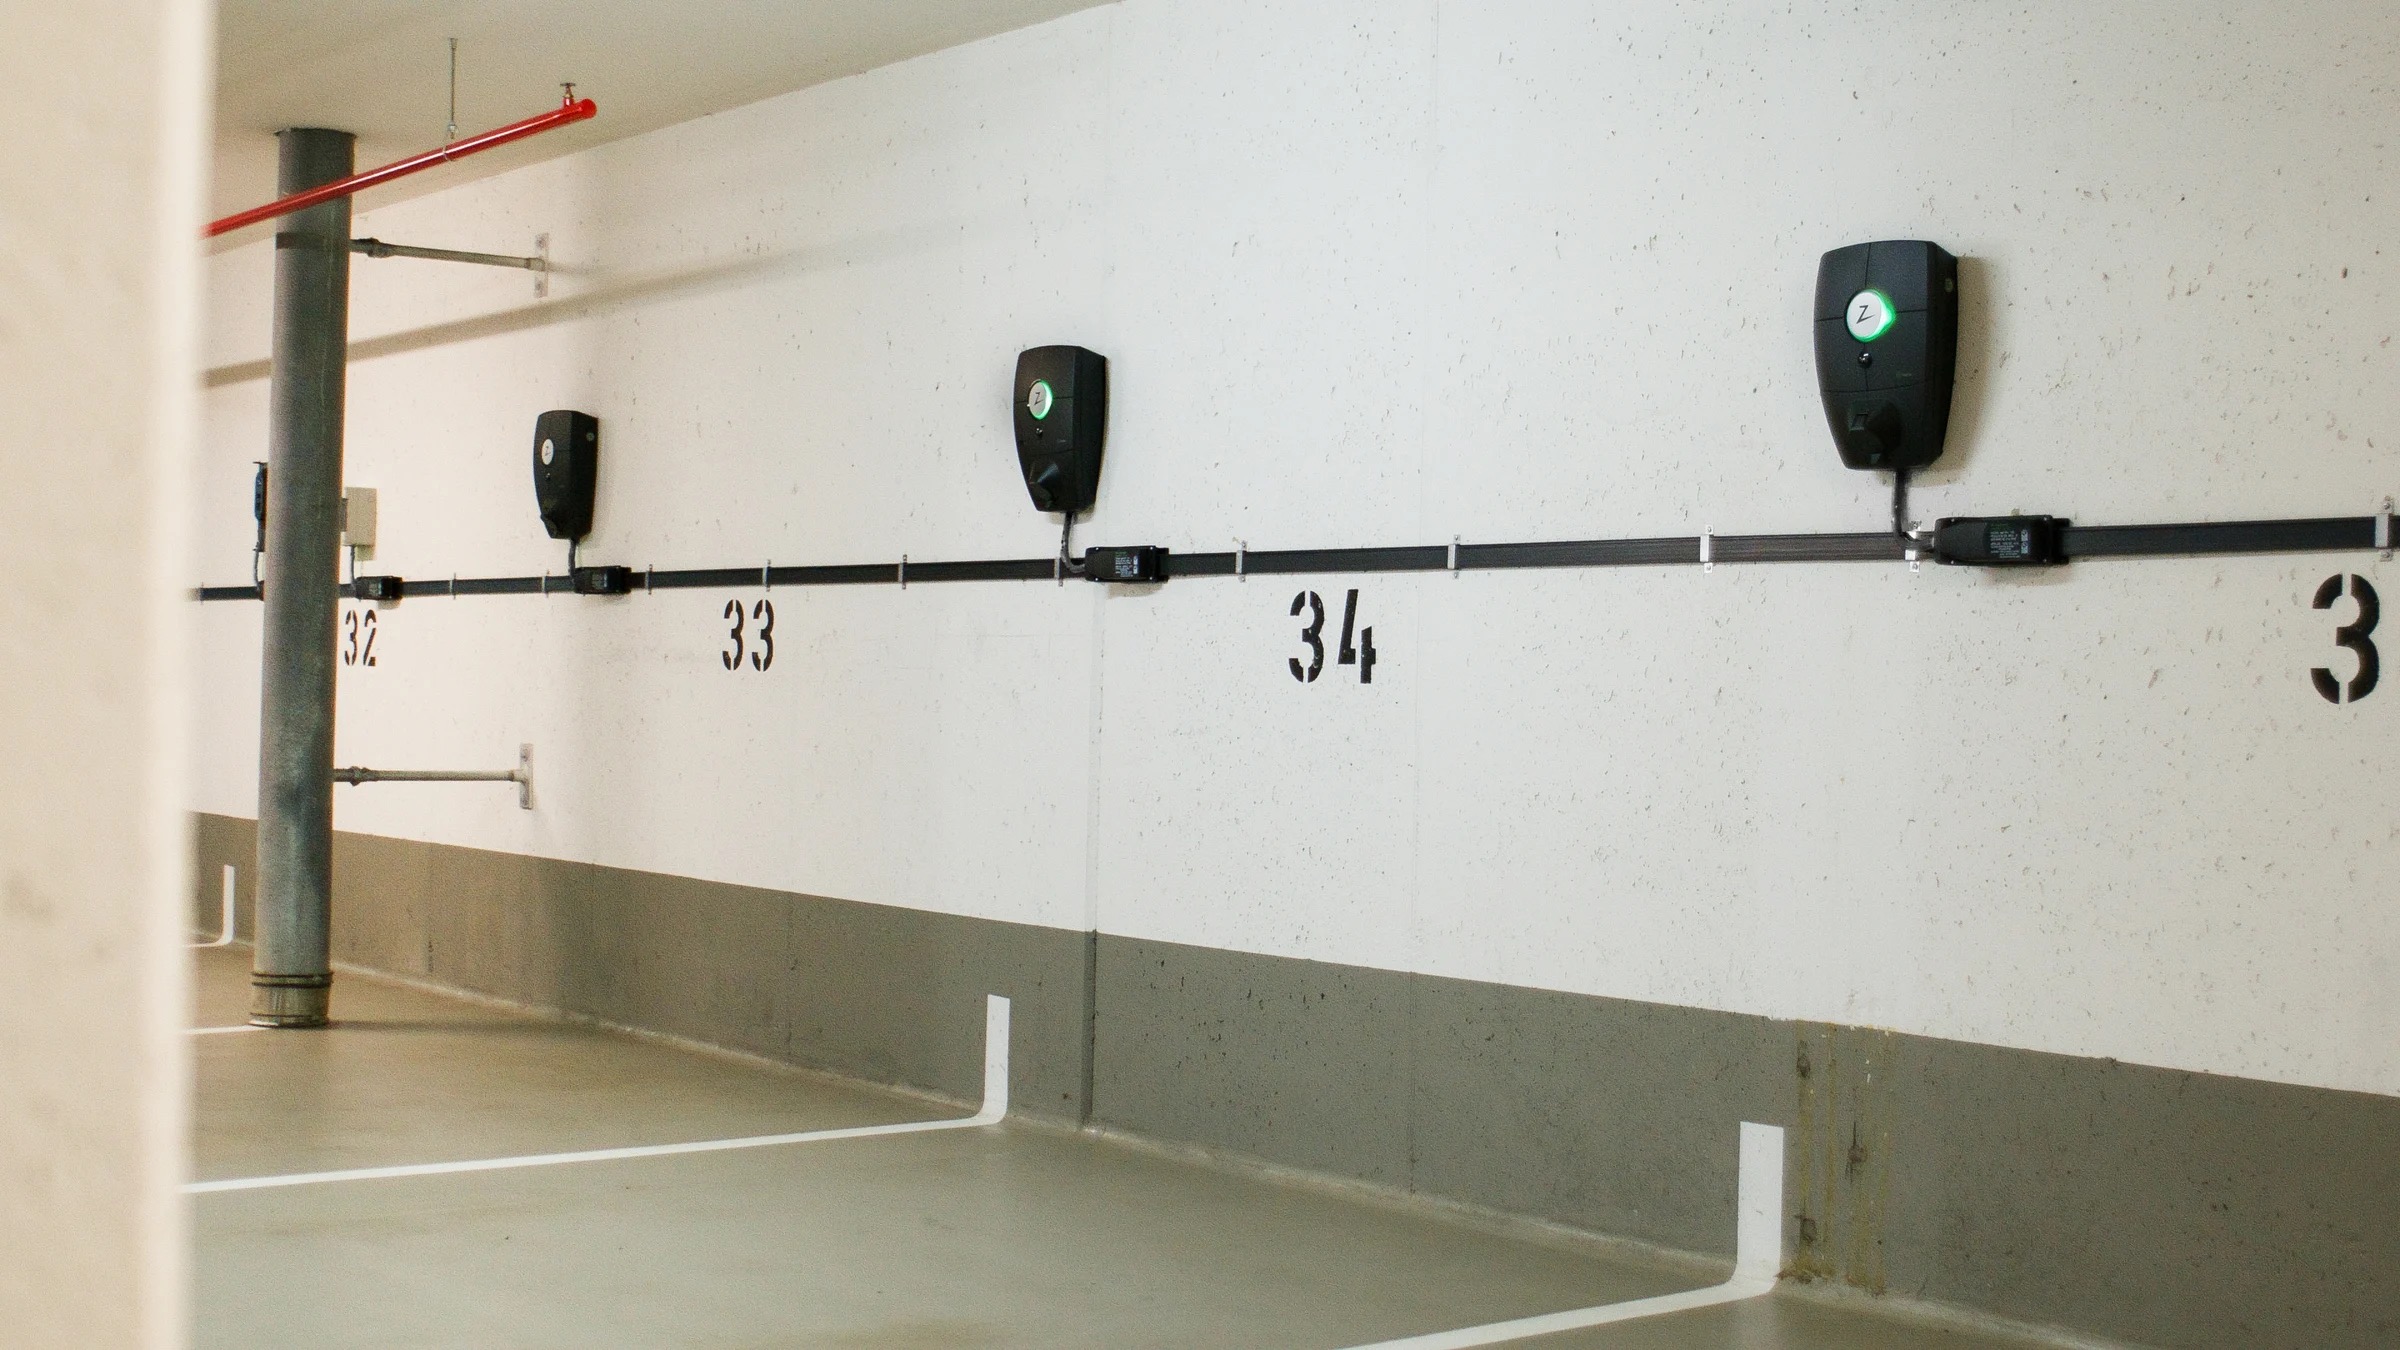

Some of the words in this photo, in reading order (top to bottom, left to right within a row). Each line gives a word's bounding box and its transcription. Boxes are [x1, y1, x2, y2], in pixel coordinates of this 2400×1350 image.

[344, 609, 377, 667] 32
[722, 599, 775, 672] 33
[1288, 588, 1377, 685] 34
[2311, 573, 2381, 705] 3
